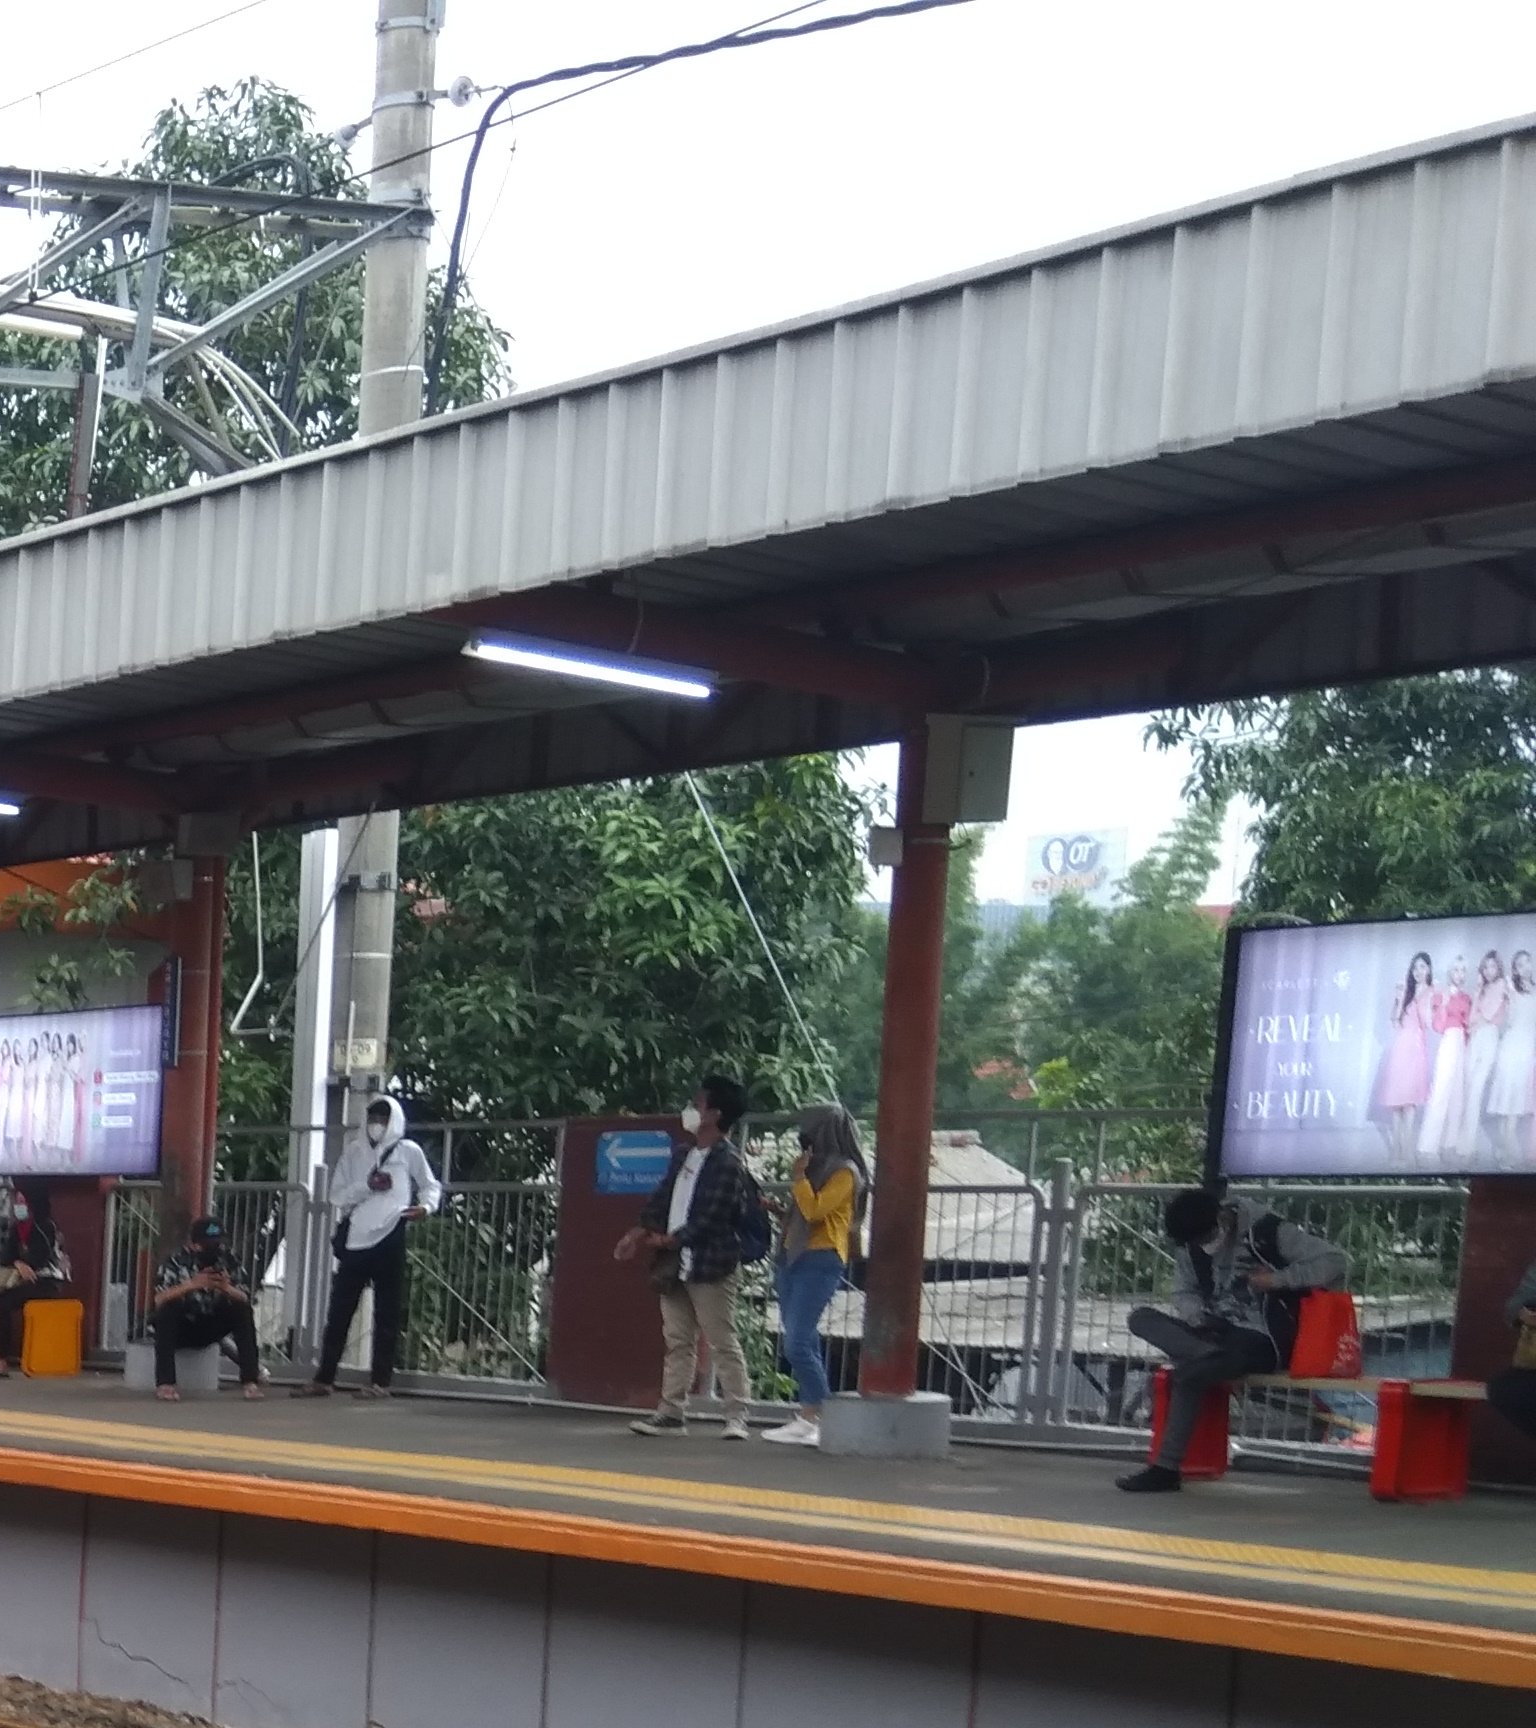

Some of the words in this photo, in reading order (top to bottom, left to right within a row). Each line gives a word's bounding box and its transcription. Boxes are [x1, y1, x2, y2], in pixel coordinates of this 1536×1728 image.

[1257, 1012, 1341, 1045] REVEAL
[1277, 1061, 1314, 1077] YOUR
[1245, 1088, 1337, 1120] BEAUTY
